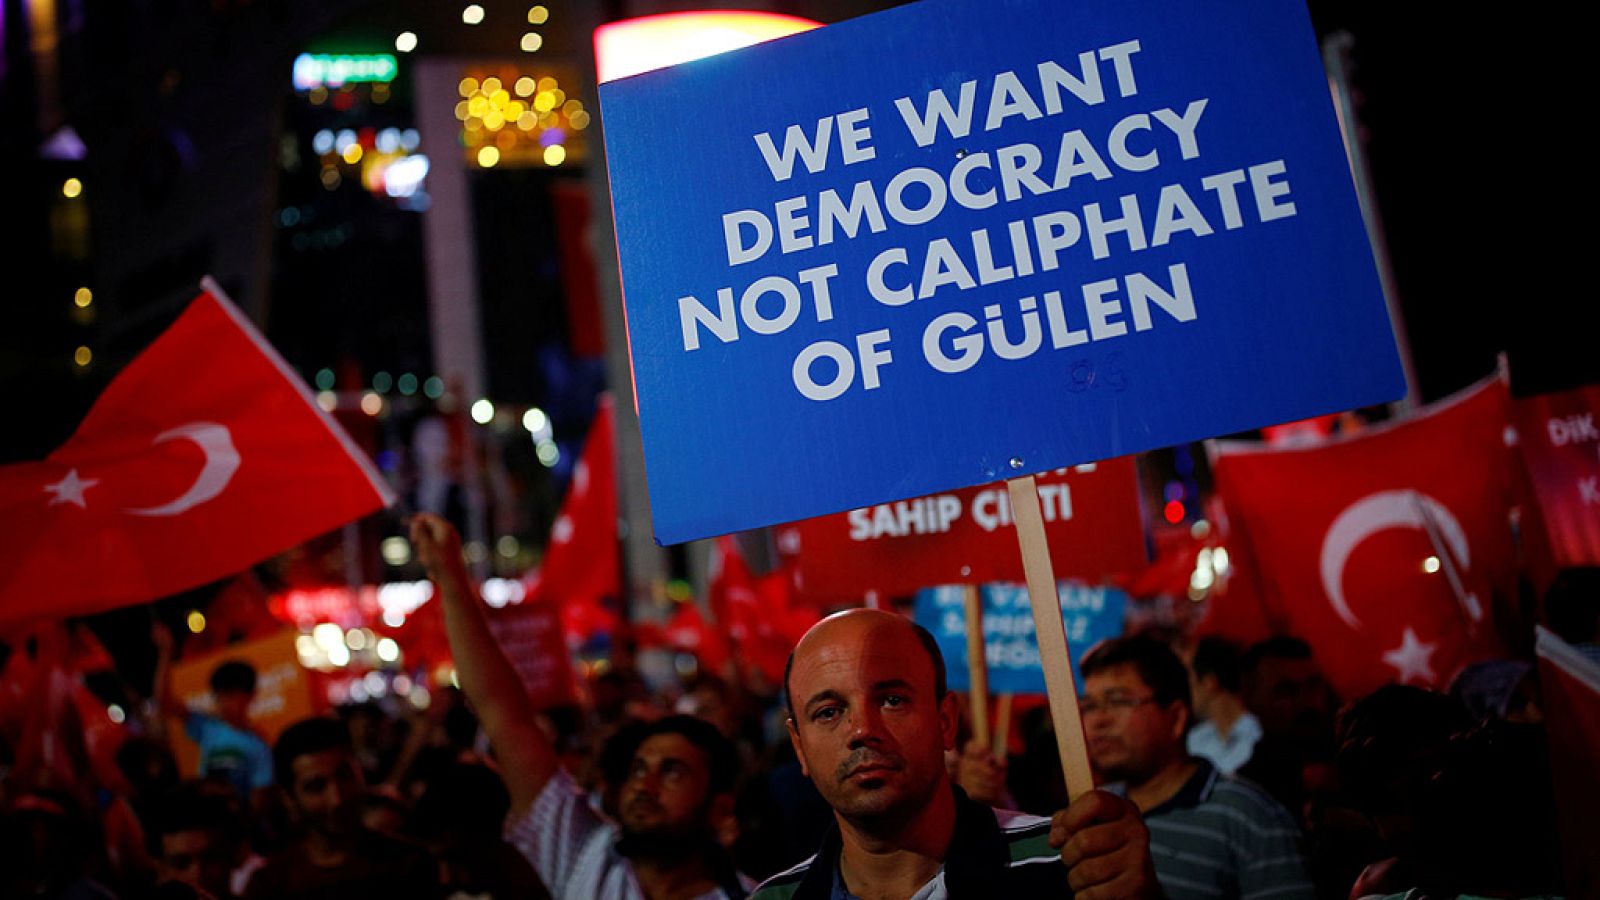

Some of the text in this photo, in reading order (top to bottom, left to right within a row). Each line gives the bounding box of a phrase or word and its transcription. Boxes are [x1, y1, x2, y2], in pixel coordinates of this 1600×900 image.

[753, 39, 1141, 182] WE WANT
[722, 98, 1208, 267] DEMOCRACY
[677, 160, 1296, 352] NOT CALIPHATE
[792, 263, 1197, 401] OF GÜLEN
[848, 483, 1073, 541] SAHİP ÇITI
